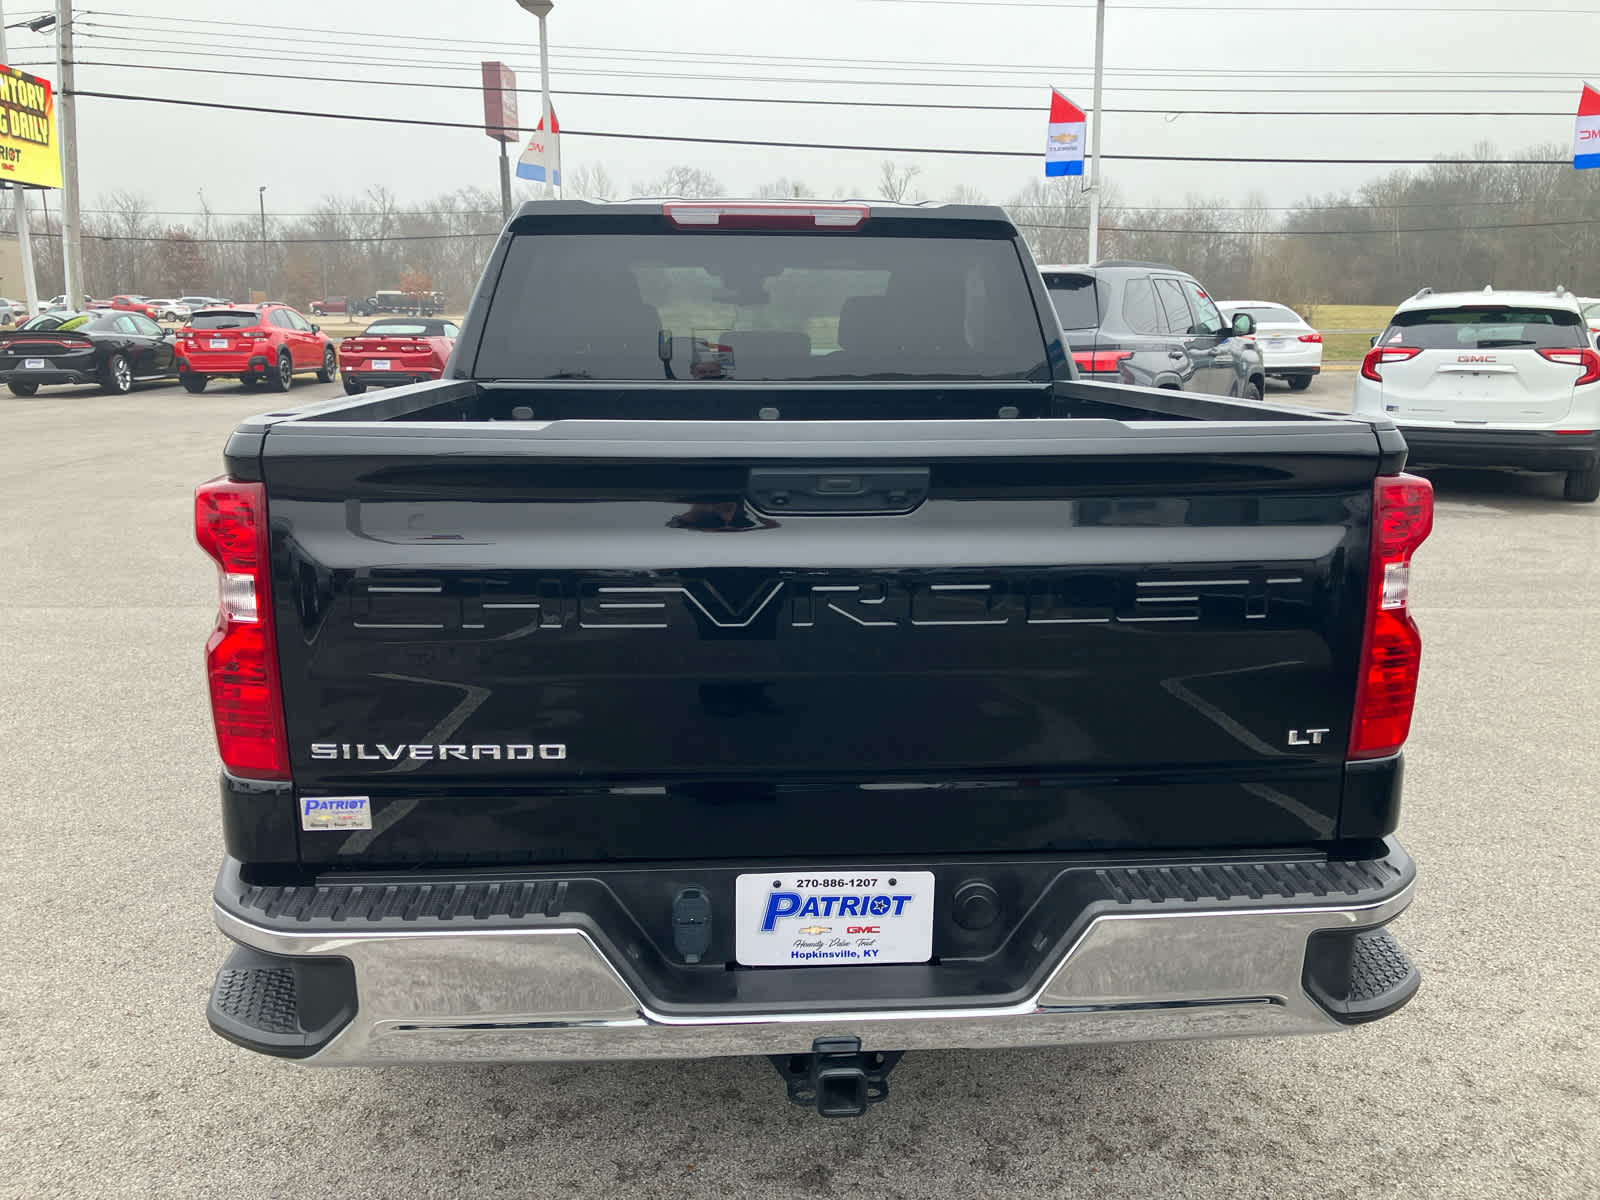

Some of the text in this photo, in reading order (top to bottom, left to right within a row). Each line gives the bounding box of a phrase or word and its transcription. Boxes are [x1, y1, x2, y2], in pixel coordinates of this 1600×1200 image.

[9, 108, 49, 145] DAILY
[1457, 355, 1497, 363] GMC
[352, 574, 1304, 629] CHEVROLET
[1288, 728, 1330, 745] LT
[311, 743, 567, 760] SILVERADO
[304, 799, 366, 816] PATRIOT
[796, 878, 878, 888] 270-886-1207
[760, 891, 913, 932] PATRIOT
[846, 925, 881, 934] GMC
[791, 949, 879, 960] Hopkinsville, KY
